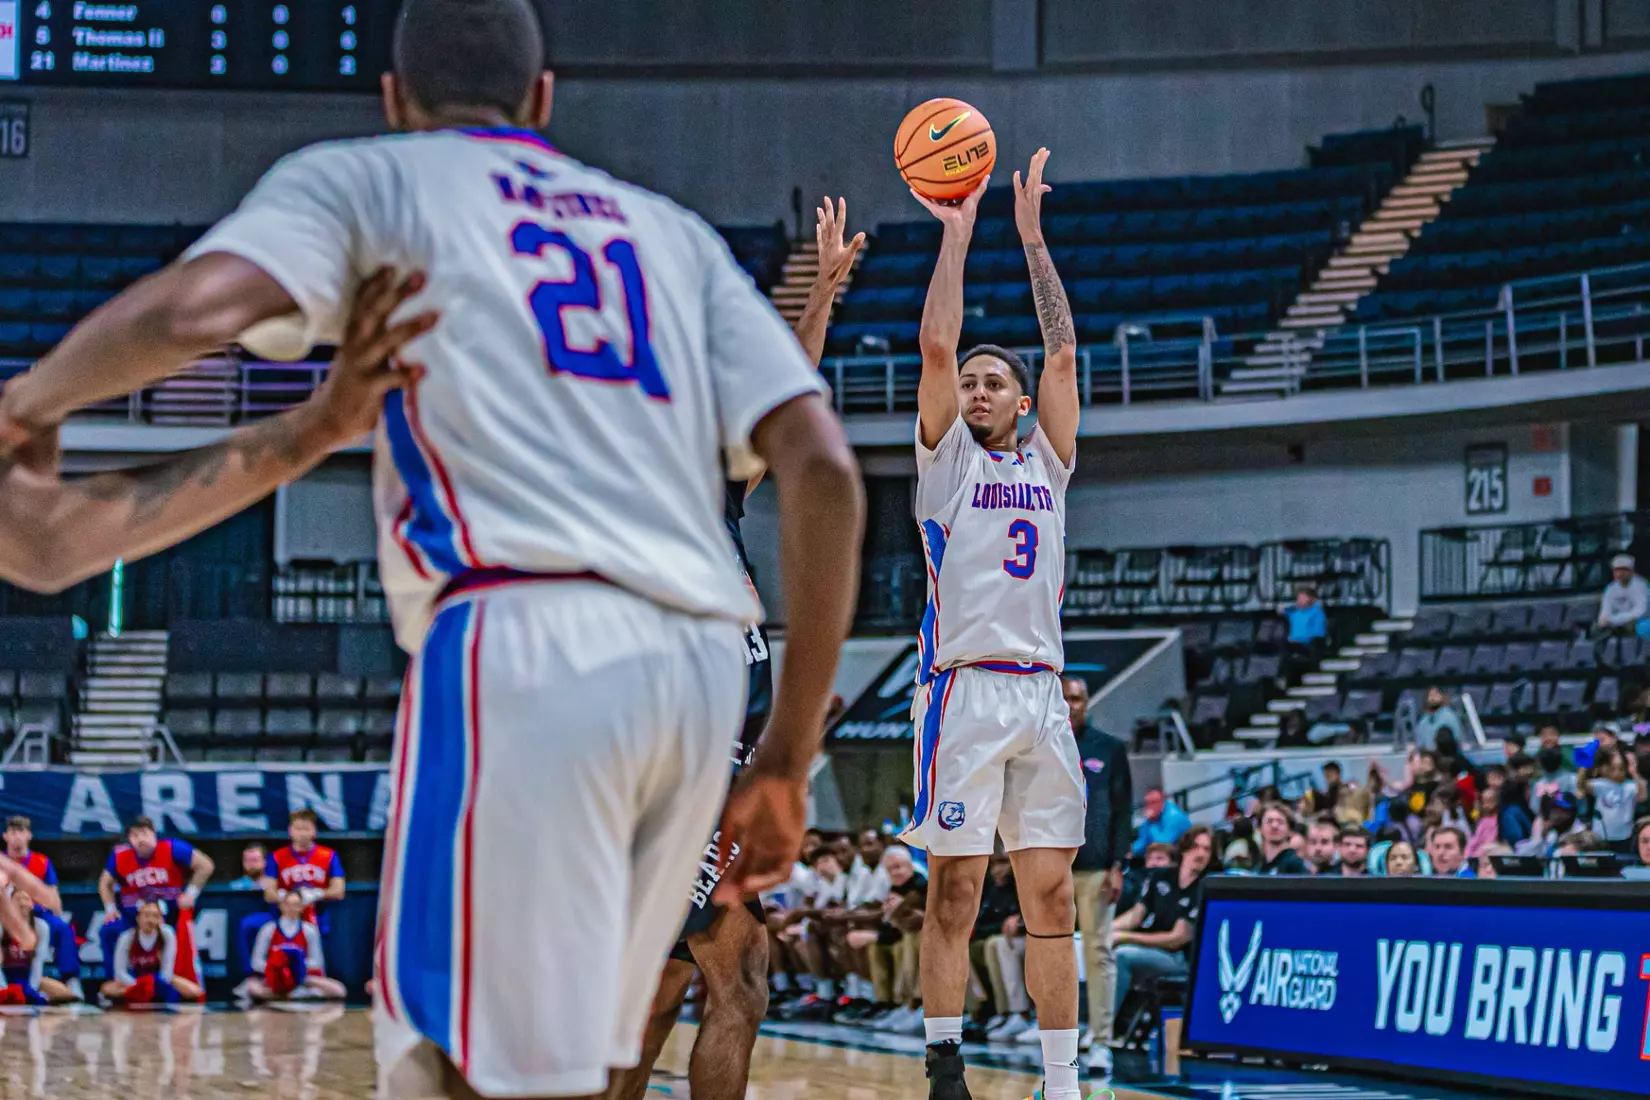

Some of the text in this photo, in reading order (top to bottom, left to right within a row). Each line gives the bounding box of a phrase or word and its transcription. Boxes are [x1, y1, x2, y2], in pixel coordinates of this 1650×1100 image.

[35, 1, 51, 19] 4
[341, 5, 356, 25] 1
[36, 25, 50, 44] 5
[73, 26, 146, 47] Thomas
[31, 51, 55, 70] 21
[73, 51, 154, 72] Martinez
[508, 219, 672, 402] 21
[1468, 468, 1503, 511] 215
[1003, 518, 1039, 580] 3
[1249, 948, 1292, 1007] AIR
[1289, 976, 1337, 1011] GUARD
[1375, 938, 1463, 1036] YOU
[1464, 944, 1626, 1053] BRING
